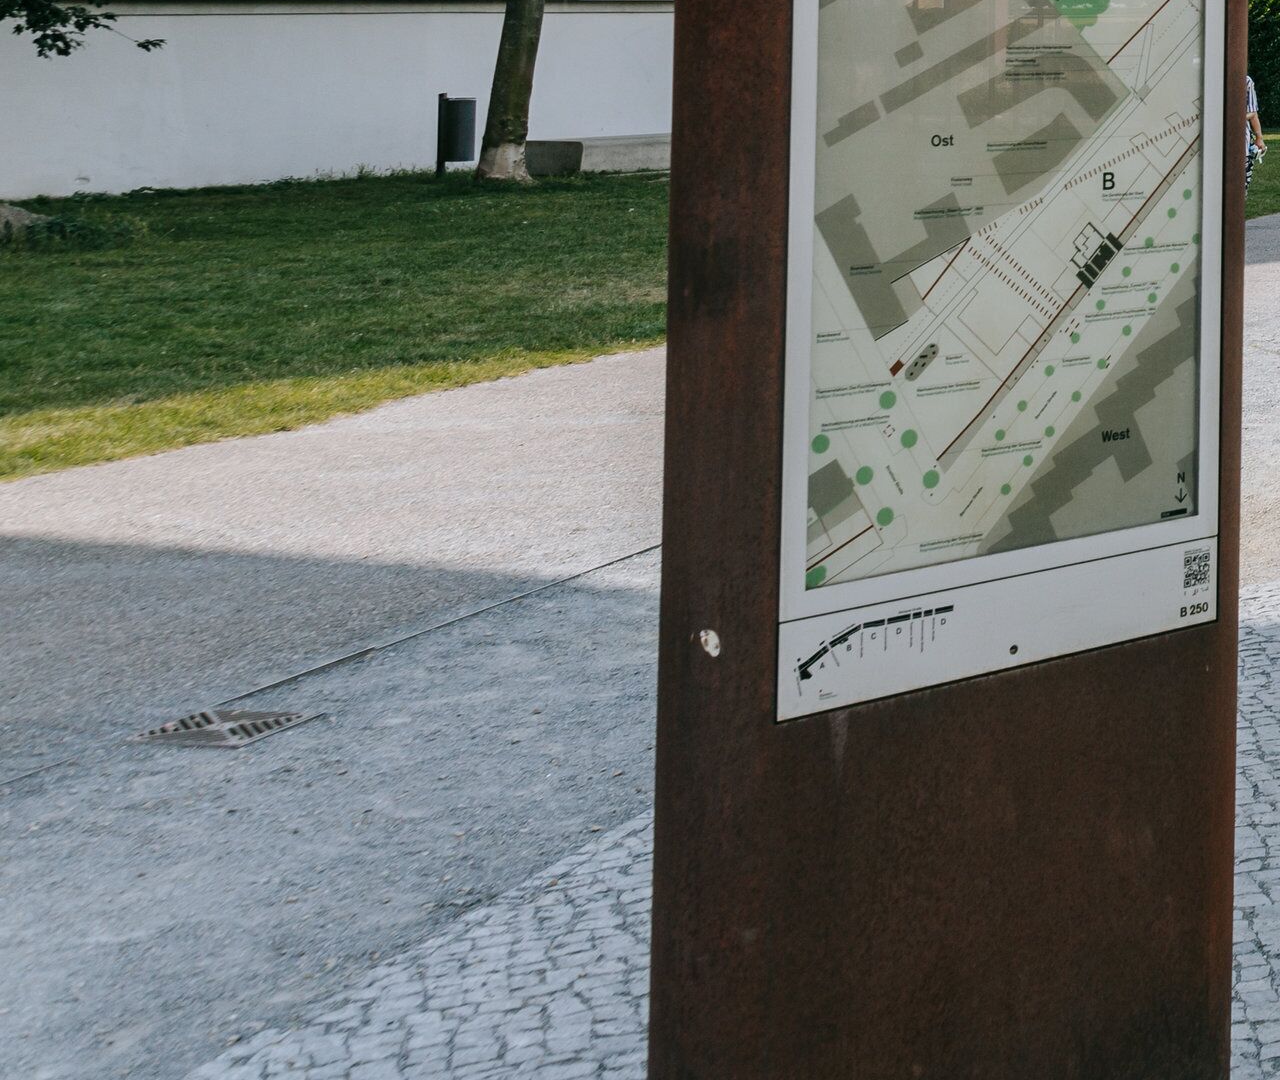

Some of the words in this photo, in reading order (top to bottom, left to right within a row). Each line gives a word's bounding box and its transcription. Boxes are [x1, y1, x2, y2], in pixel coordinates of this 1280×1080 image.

[931, 134, 954, 147] Ost
[1102, 172, 1115, 190] B
[1102, 427, 1130, 443] West
[1177, 472, 1185, 483] N
[1180, 606, 1187, 617] B
[1189, 602, 1209, 616] 250
